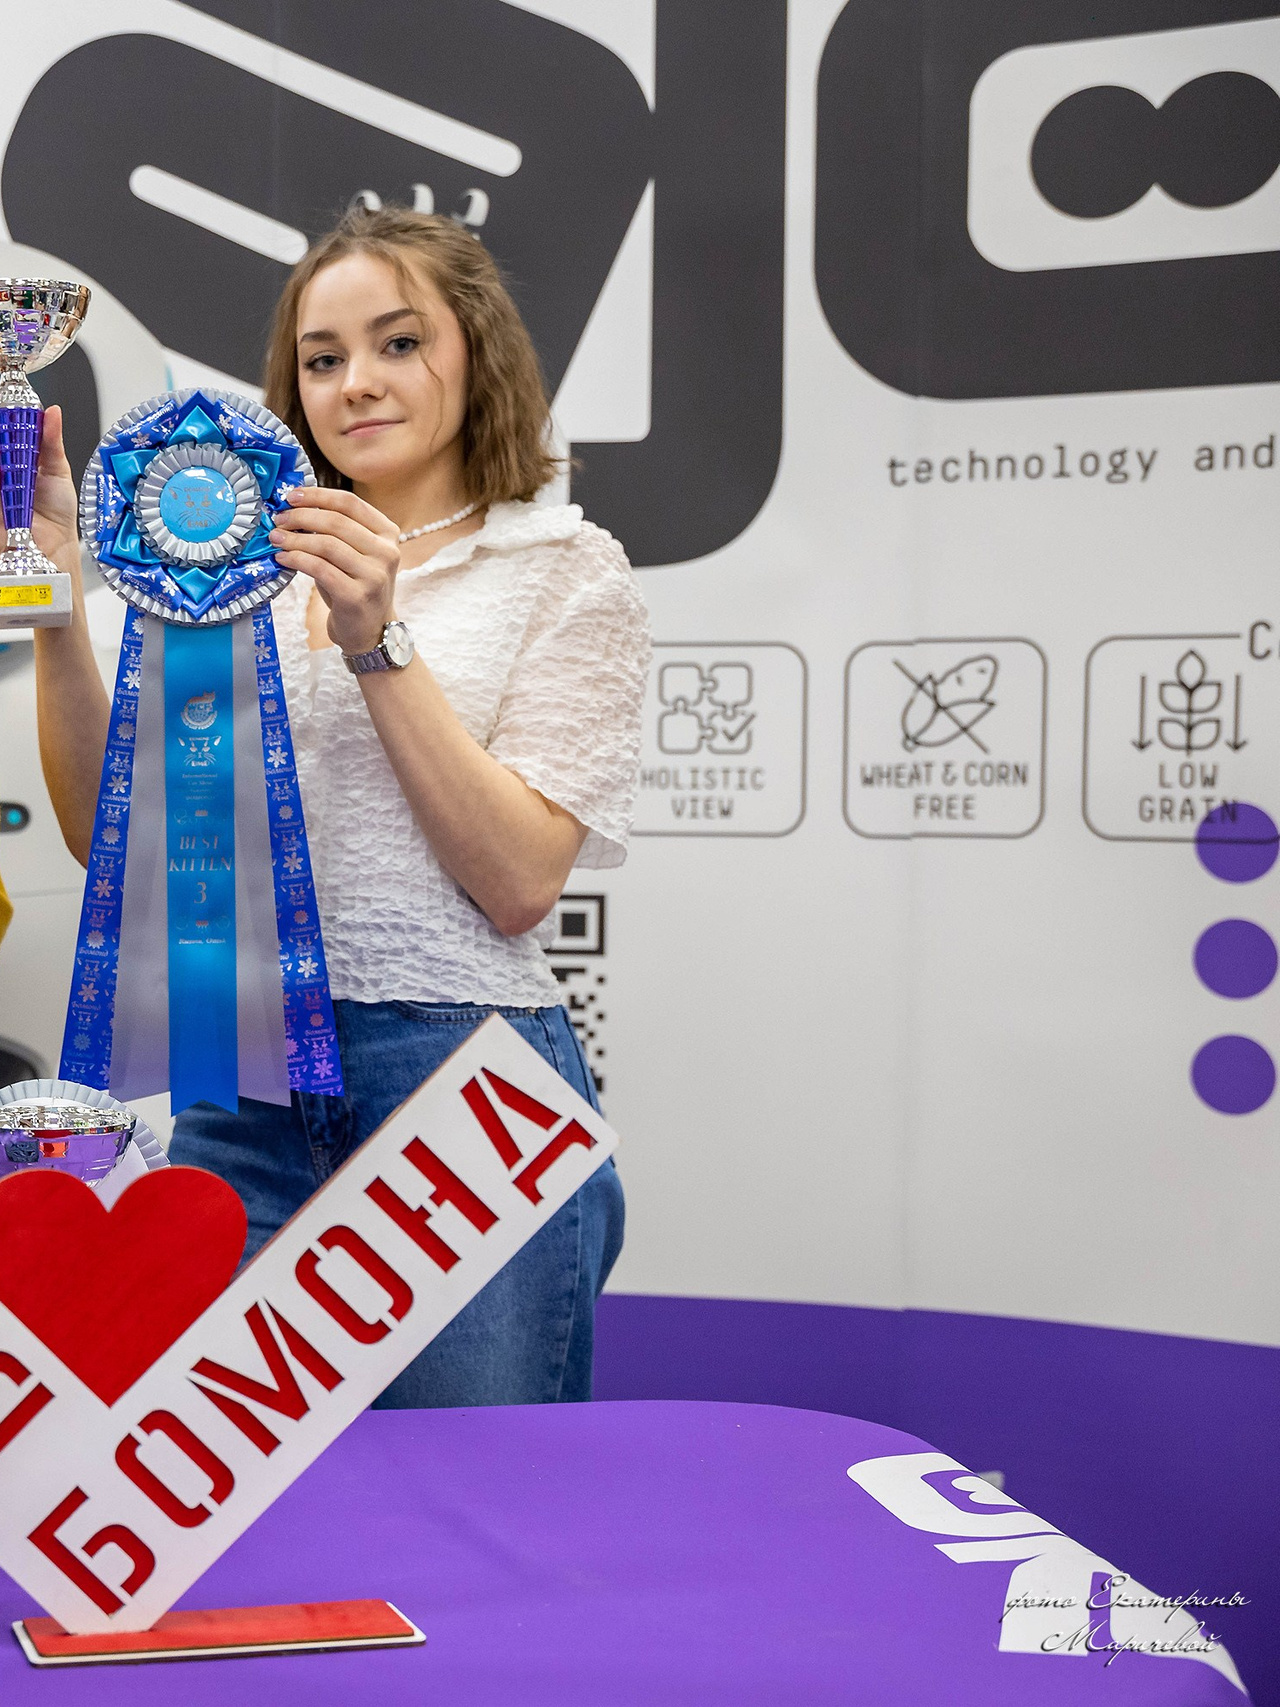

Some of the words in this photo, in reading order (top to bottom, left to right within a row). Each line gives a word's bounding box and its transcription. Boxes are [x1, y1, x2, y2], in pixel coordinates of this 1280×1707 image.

[888, 443, 1158, 486] technology
[1194, 434, 1277, 472] and
[640, 766, 767, 792] HOLISTIC
[860, 762, 937, 788] WHEAT
[963, 761, 1029, 787] CORN
[1158, 762, 1219, 789] LOW
[671, 796, 734, 821] VIEW
[913, 795, 976, 821] FREE
[1138, 796, 1239, 825] GRAIN
[179, 835, 219, 850] BEST
[168, 857, 233, 872] KITTEN
[193, 882, 207, 904] 3
[27, 1067, 598, 1618] БОМОНД
